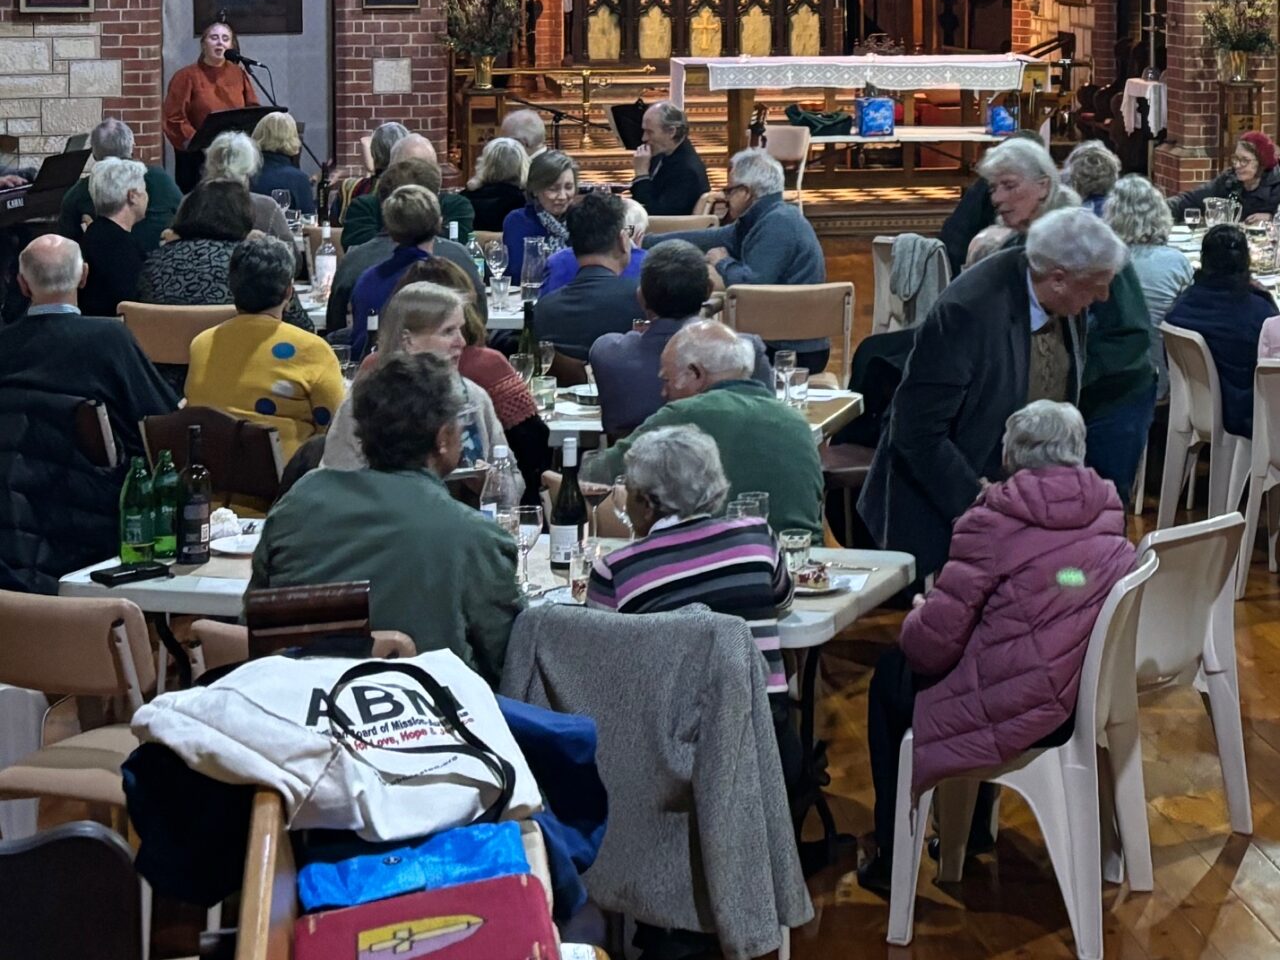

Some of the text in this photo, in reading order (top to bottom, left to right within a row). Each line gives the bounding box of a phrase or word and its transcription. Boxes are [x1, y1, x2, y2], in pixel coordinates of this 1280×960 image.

[305, 685, 465, 727] ABM
[380, 722, 390, 733] of
[400, 728, 428, 741] Hope
